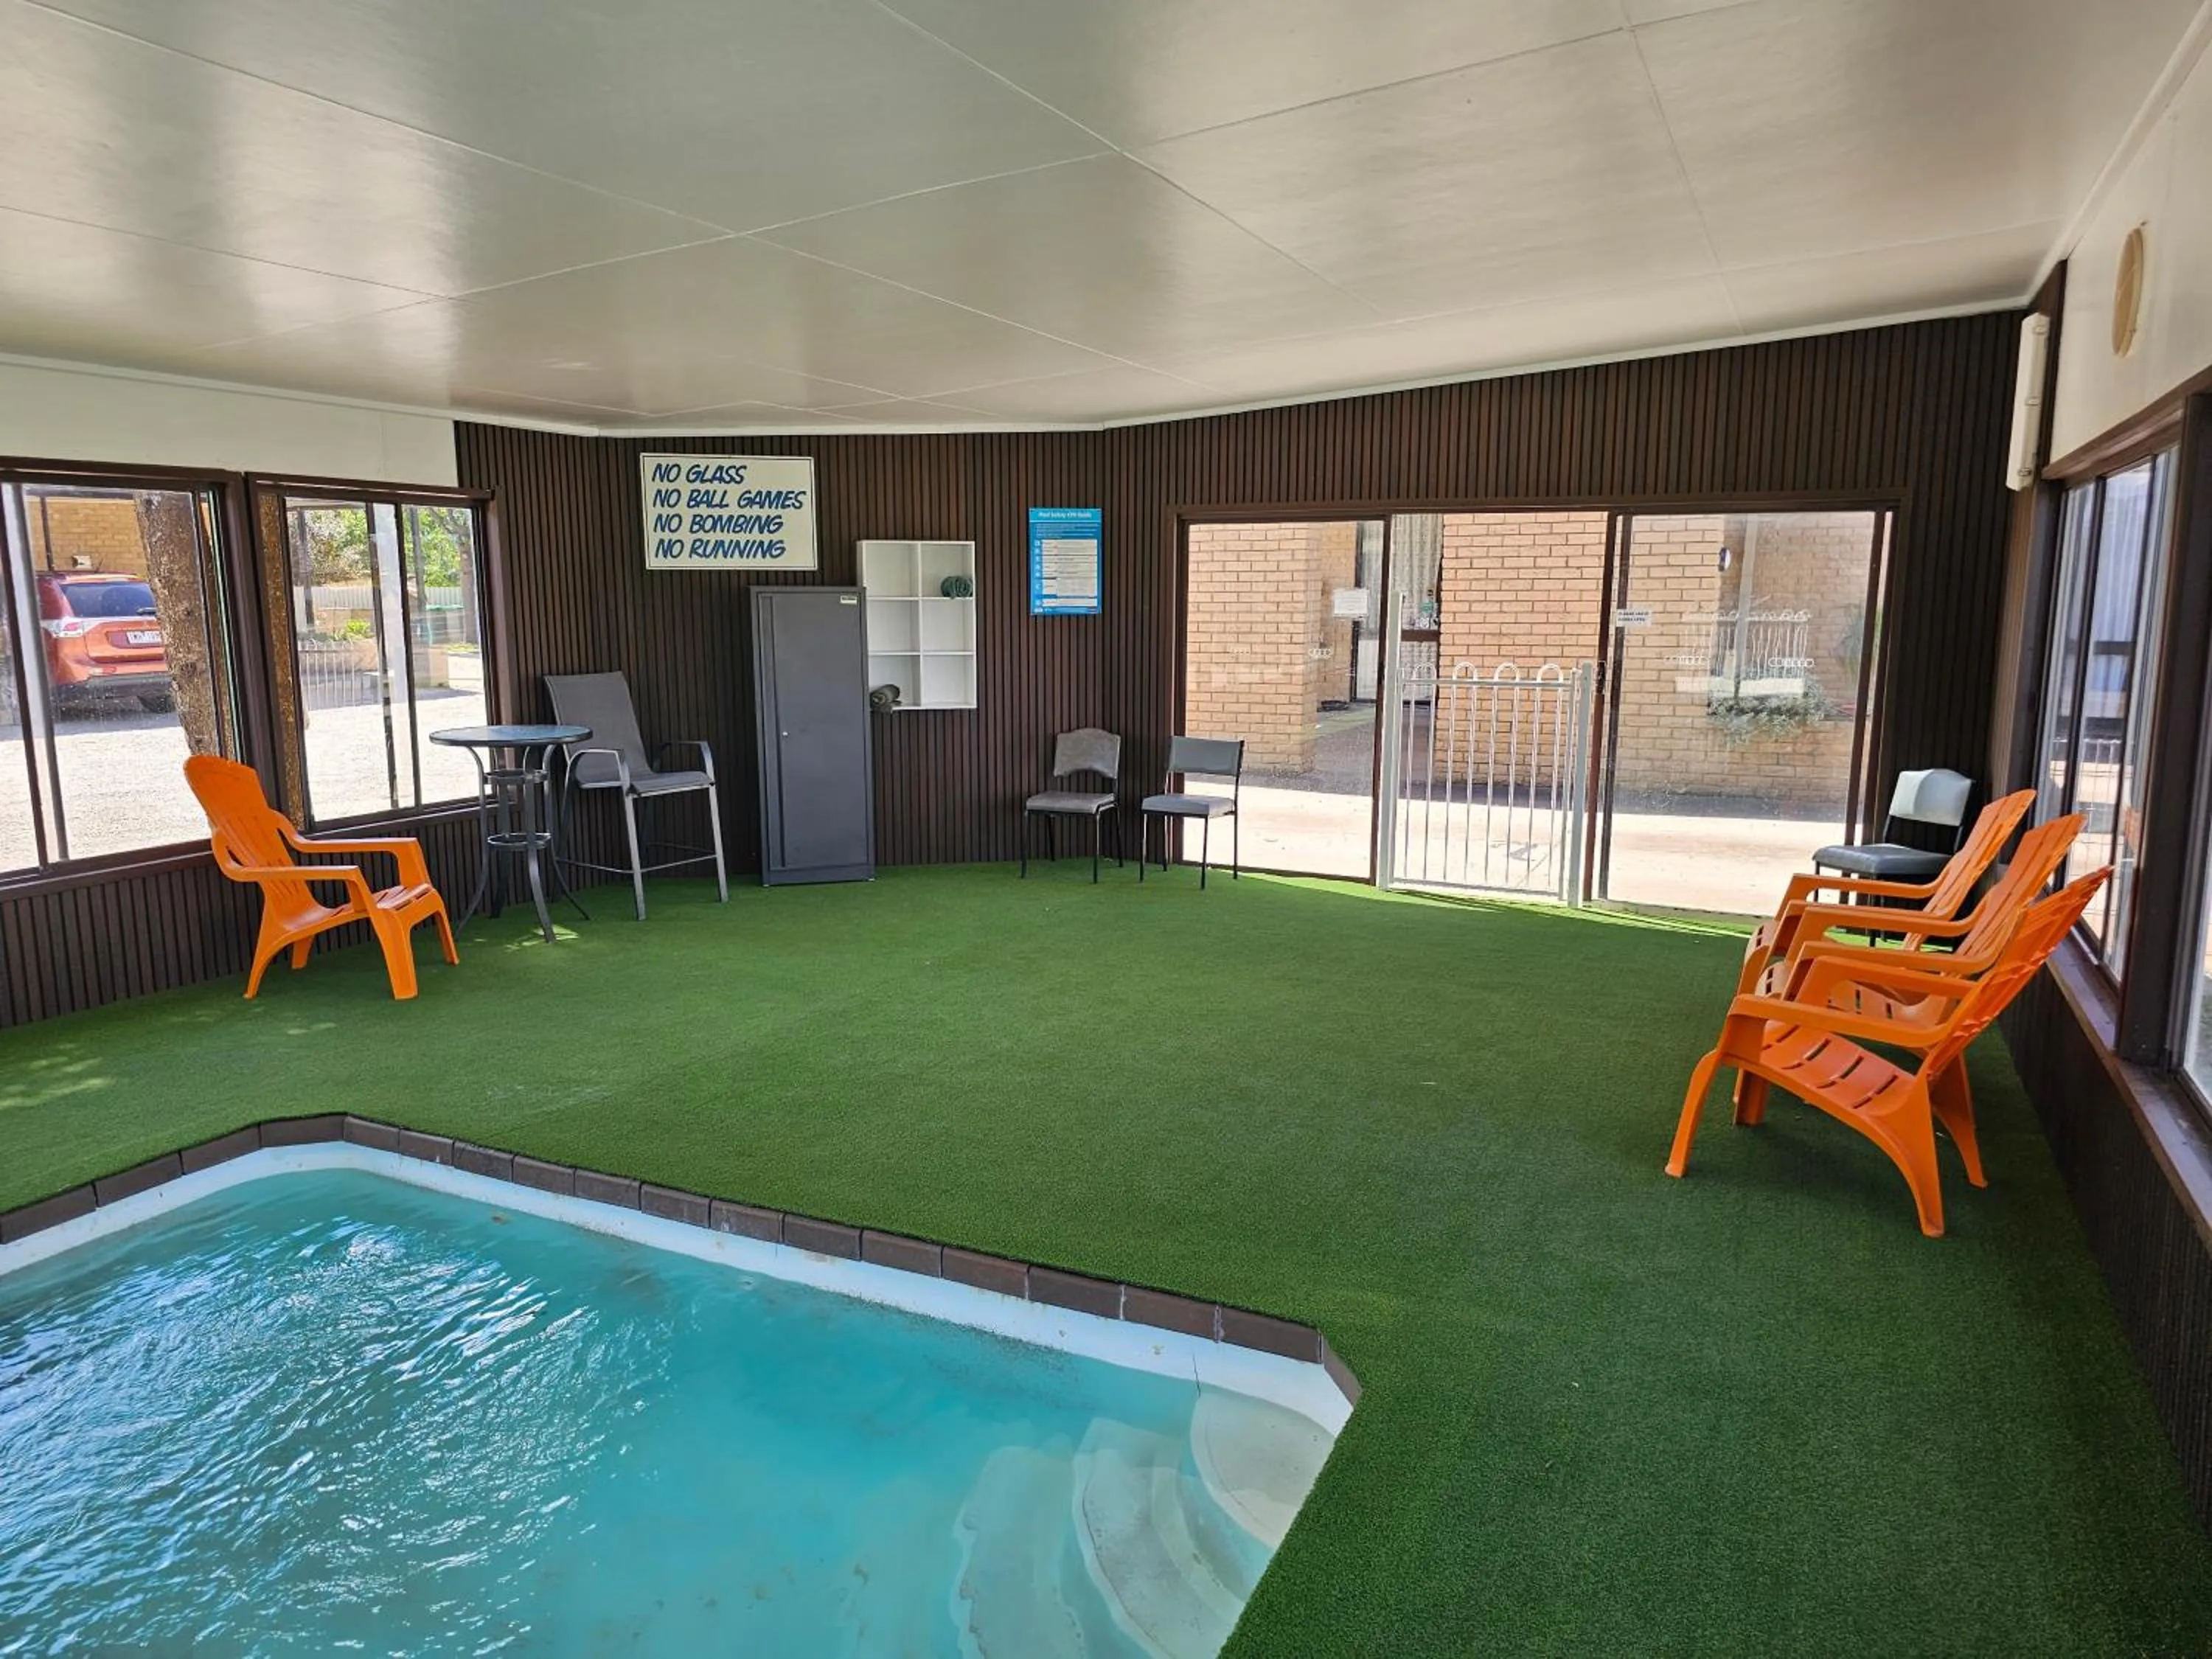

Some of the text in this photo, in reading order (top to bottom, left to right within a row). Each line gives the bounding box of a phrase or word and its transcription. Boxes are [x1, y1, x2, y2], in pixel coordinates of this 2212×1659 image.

[651, 462, 748, 485] NO GLASS
[653, 487, 807, 510] NO BALL GAMES
[653, 512, 784, 535] NO BOMBING
[654, 538, 787, 560] NO RUNNING
